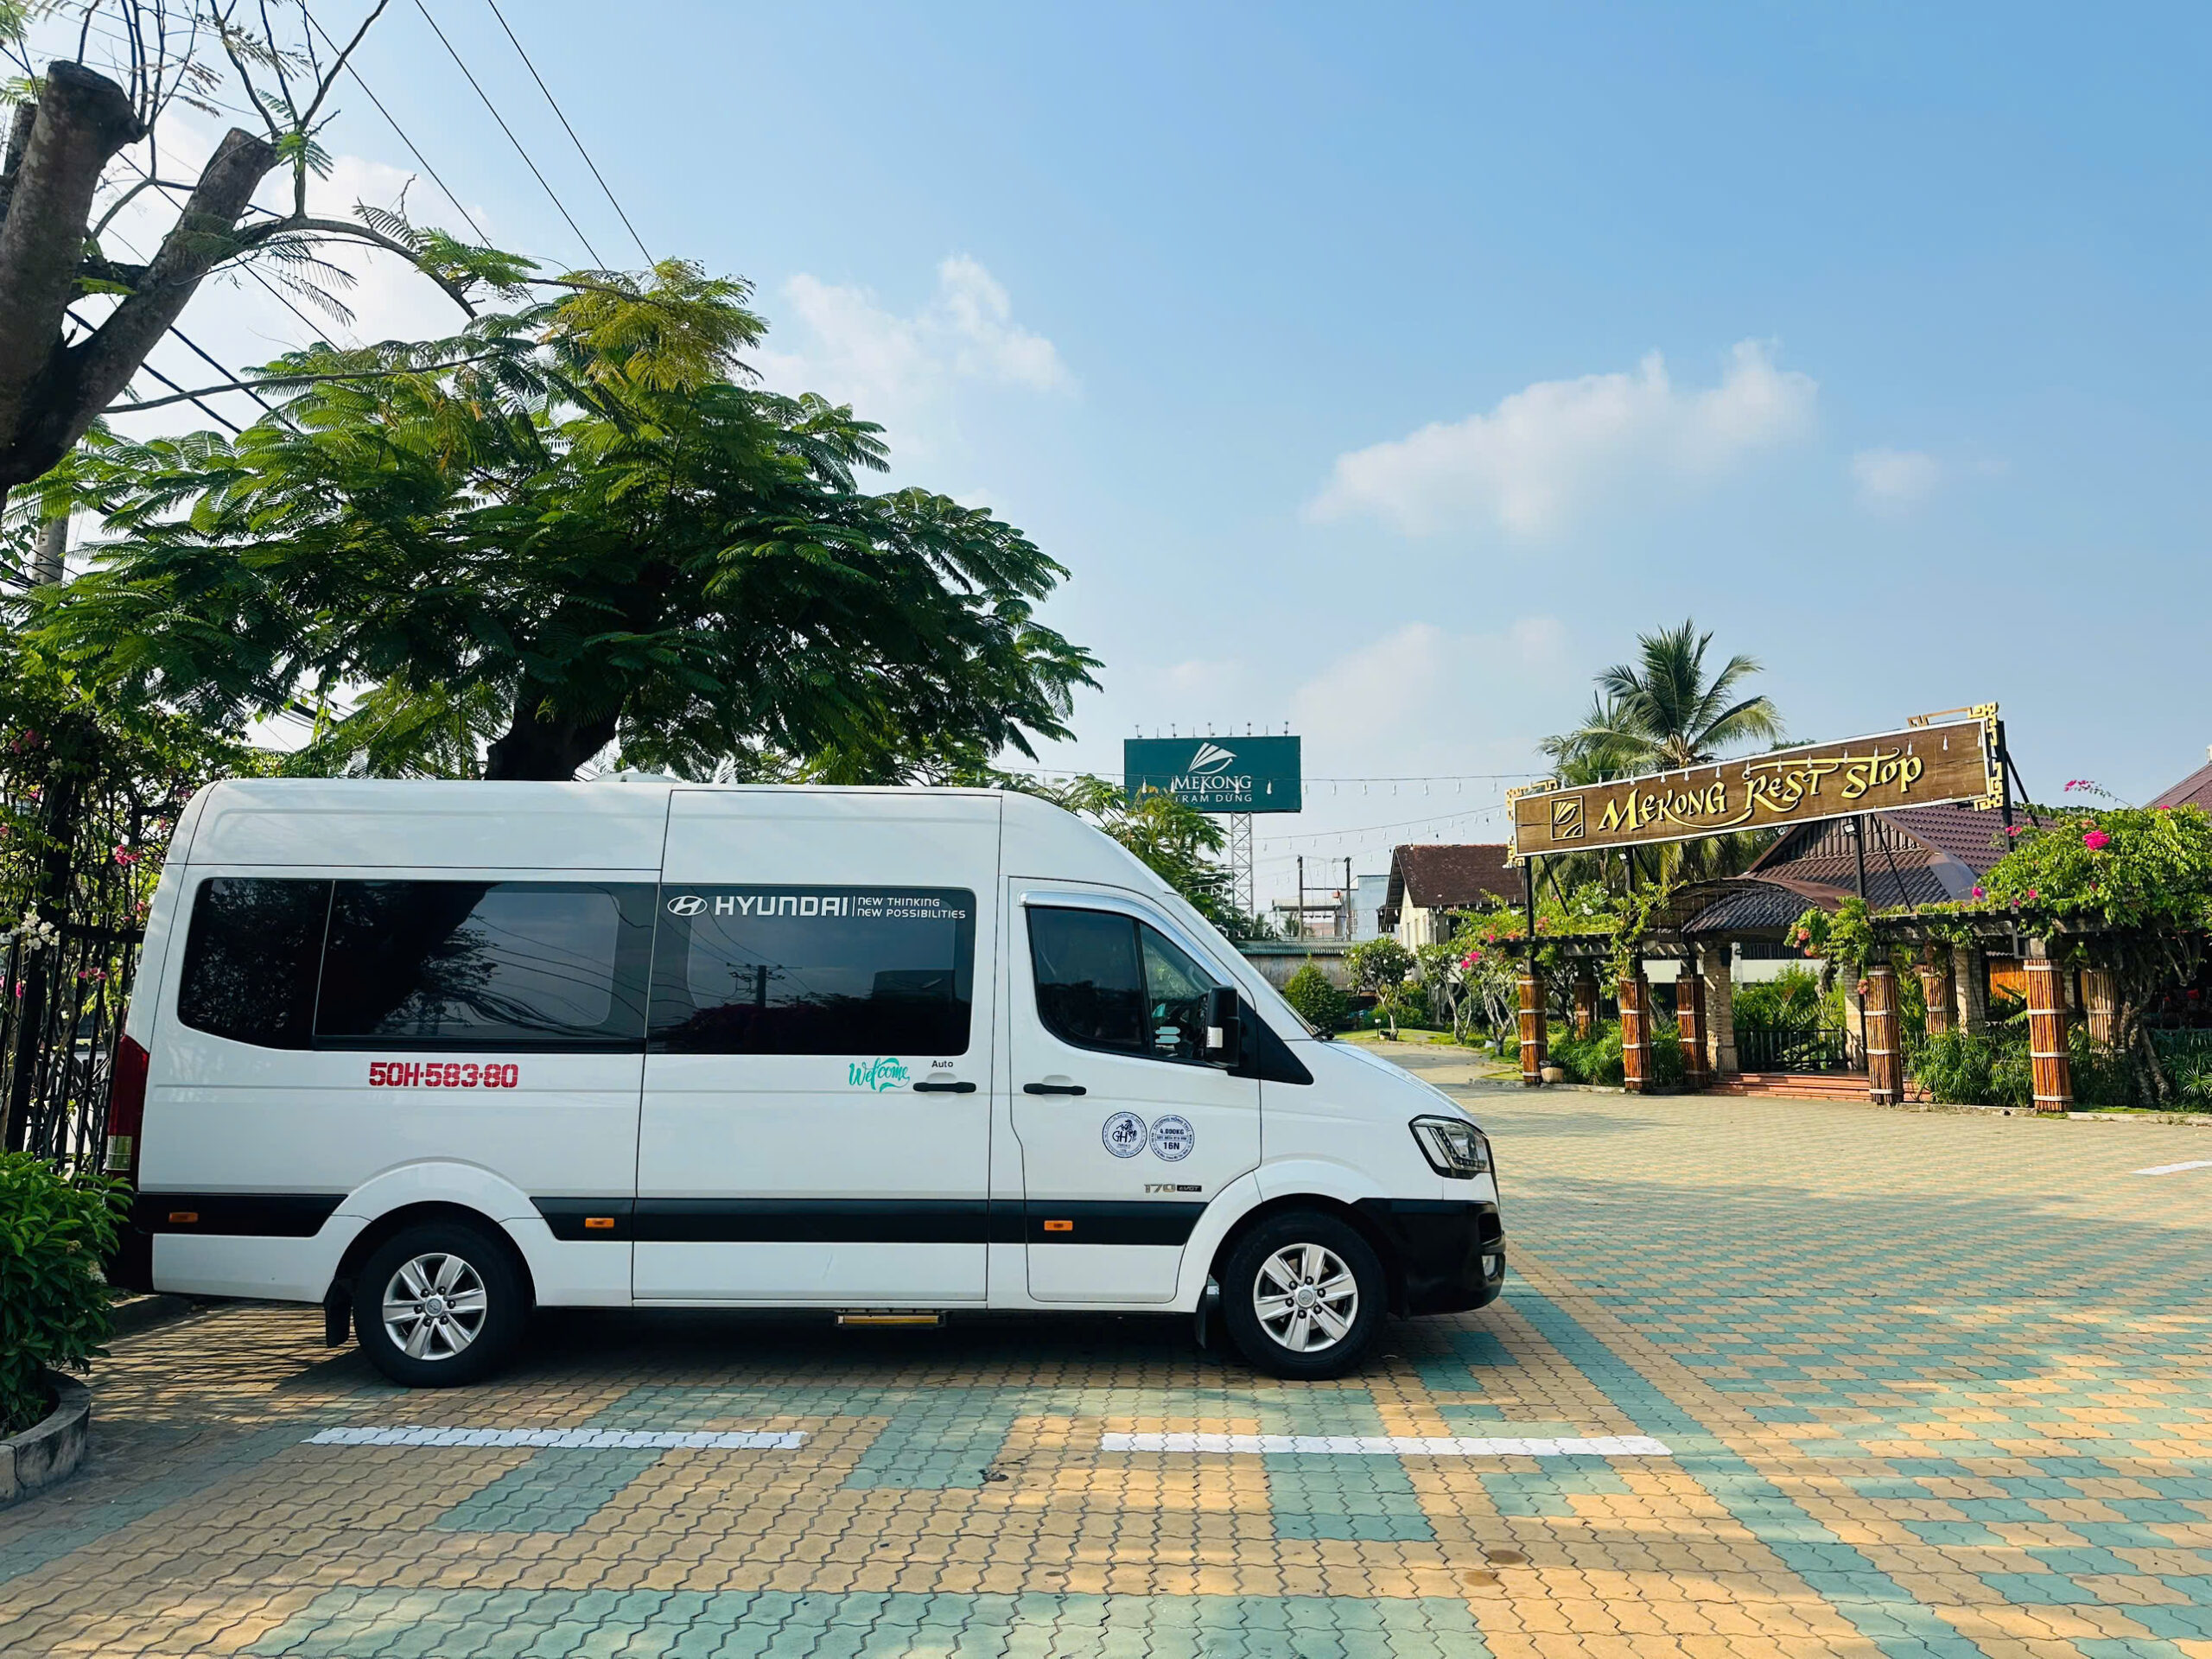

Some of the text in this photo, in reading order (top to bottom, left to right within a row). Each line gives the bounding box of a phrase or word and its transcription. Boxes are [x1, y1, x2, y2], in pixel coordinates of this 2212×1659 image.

[1174, 775, 1252, 790] MEKONG
[1215, 792, 1252, 803] DỪNG
[715, 896, 849, 917] HYUNDAI
[857, 897, 940, 907] NEW THINKING
[857, 908, 967, 919] NEW POSSIBILITIES
[849, 1058, 911, 1092] Welcome
[1163, 1141, 1180, 1150] 16N
